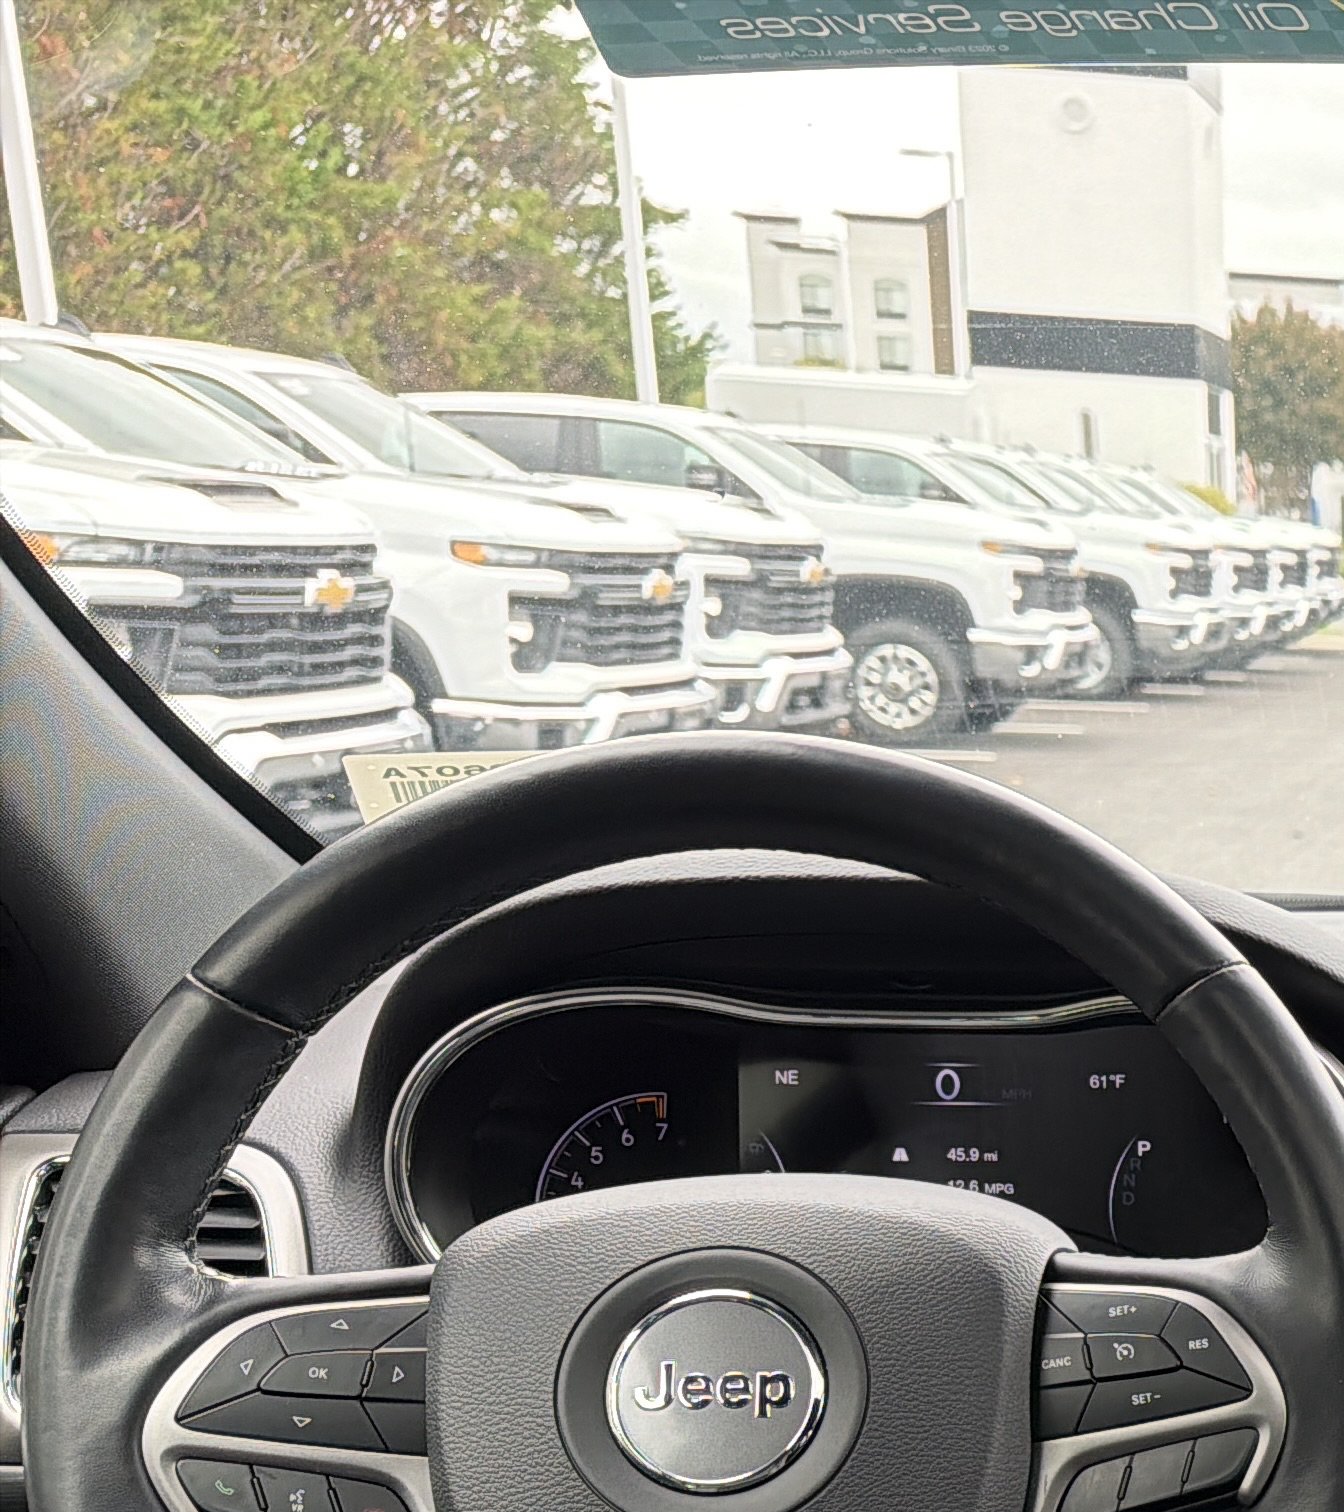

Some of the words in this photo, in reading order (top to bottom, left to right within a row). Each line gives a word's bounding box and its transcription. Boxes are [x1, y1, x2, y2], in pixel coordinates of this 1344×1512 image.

[775, 1070, 799, 1085] NE
[935, 1069, 960, 1100] 0
[1089, 1075, 1125, 1089] 61°F
[621, 1129, 634, 1147] 6
[655, 1123, 669, 1141] 7
[589, 1147, 603, 1165] 5
[947, 1148, 979, 1162] 45.9
[984, 1149, 998, 1162] mi
[1137, 1142, 1151, 1156] P
[571, 1172, 584, 1189] 4
[985, 1183, 1014, 1195] MPG
[1188, 1339, 1209, 1350] RES
[1041, 1356, 1072, 1370] CANC
[308, 1367, 328, 1380] OK
[633, 1360, 796, 1419] Jeep
